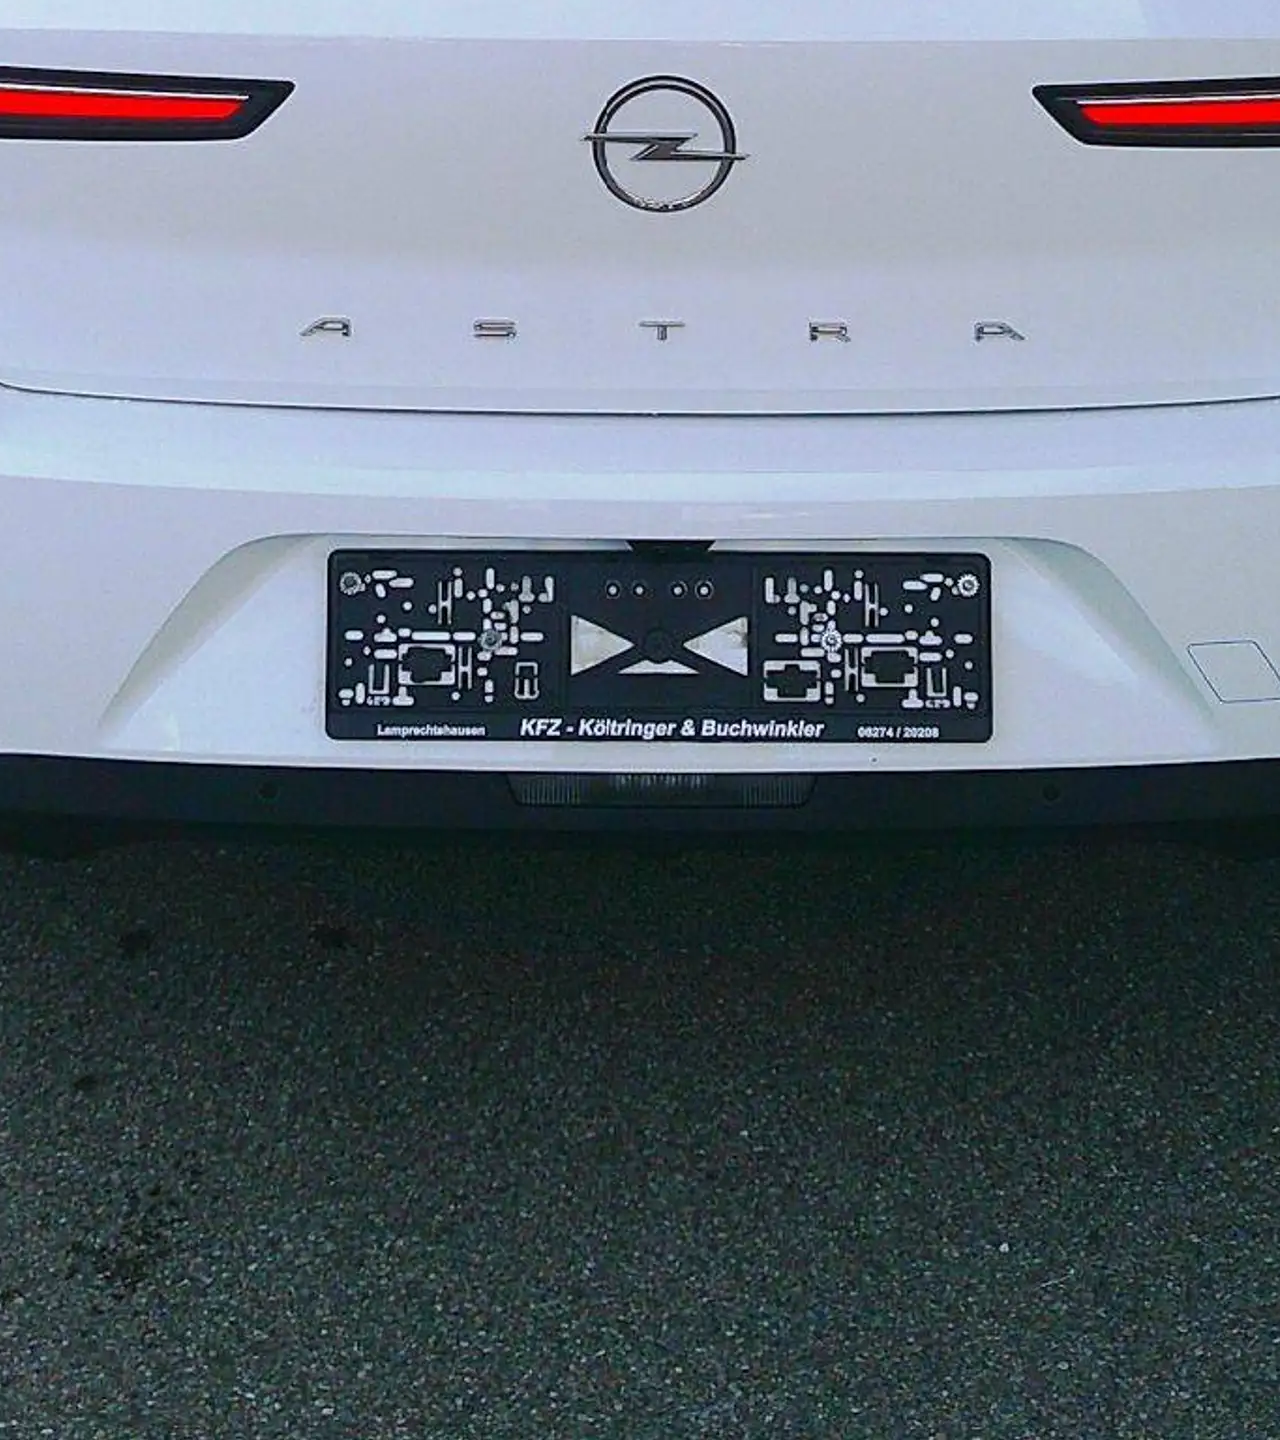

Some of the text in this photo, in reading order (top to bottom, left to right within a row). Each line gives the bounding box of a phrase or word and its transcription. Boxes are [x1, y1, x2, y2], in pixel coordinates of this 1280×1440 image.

[300, 317, 1025, 342] ASTRA
[519, 718, 562, 736] KFZ
[578, 718, 677, 740] Költringer
[680, 719, 696, 737] &
[700, 719, 825, 737] Buchwinkler
